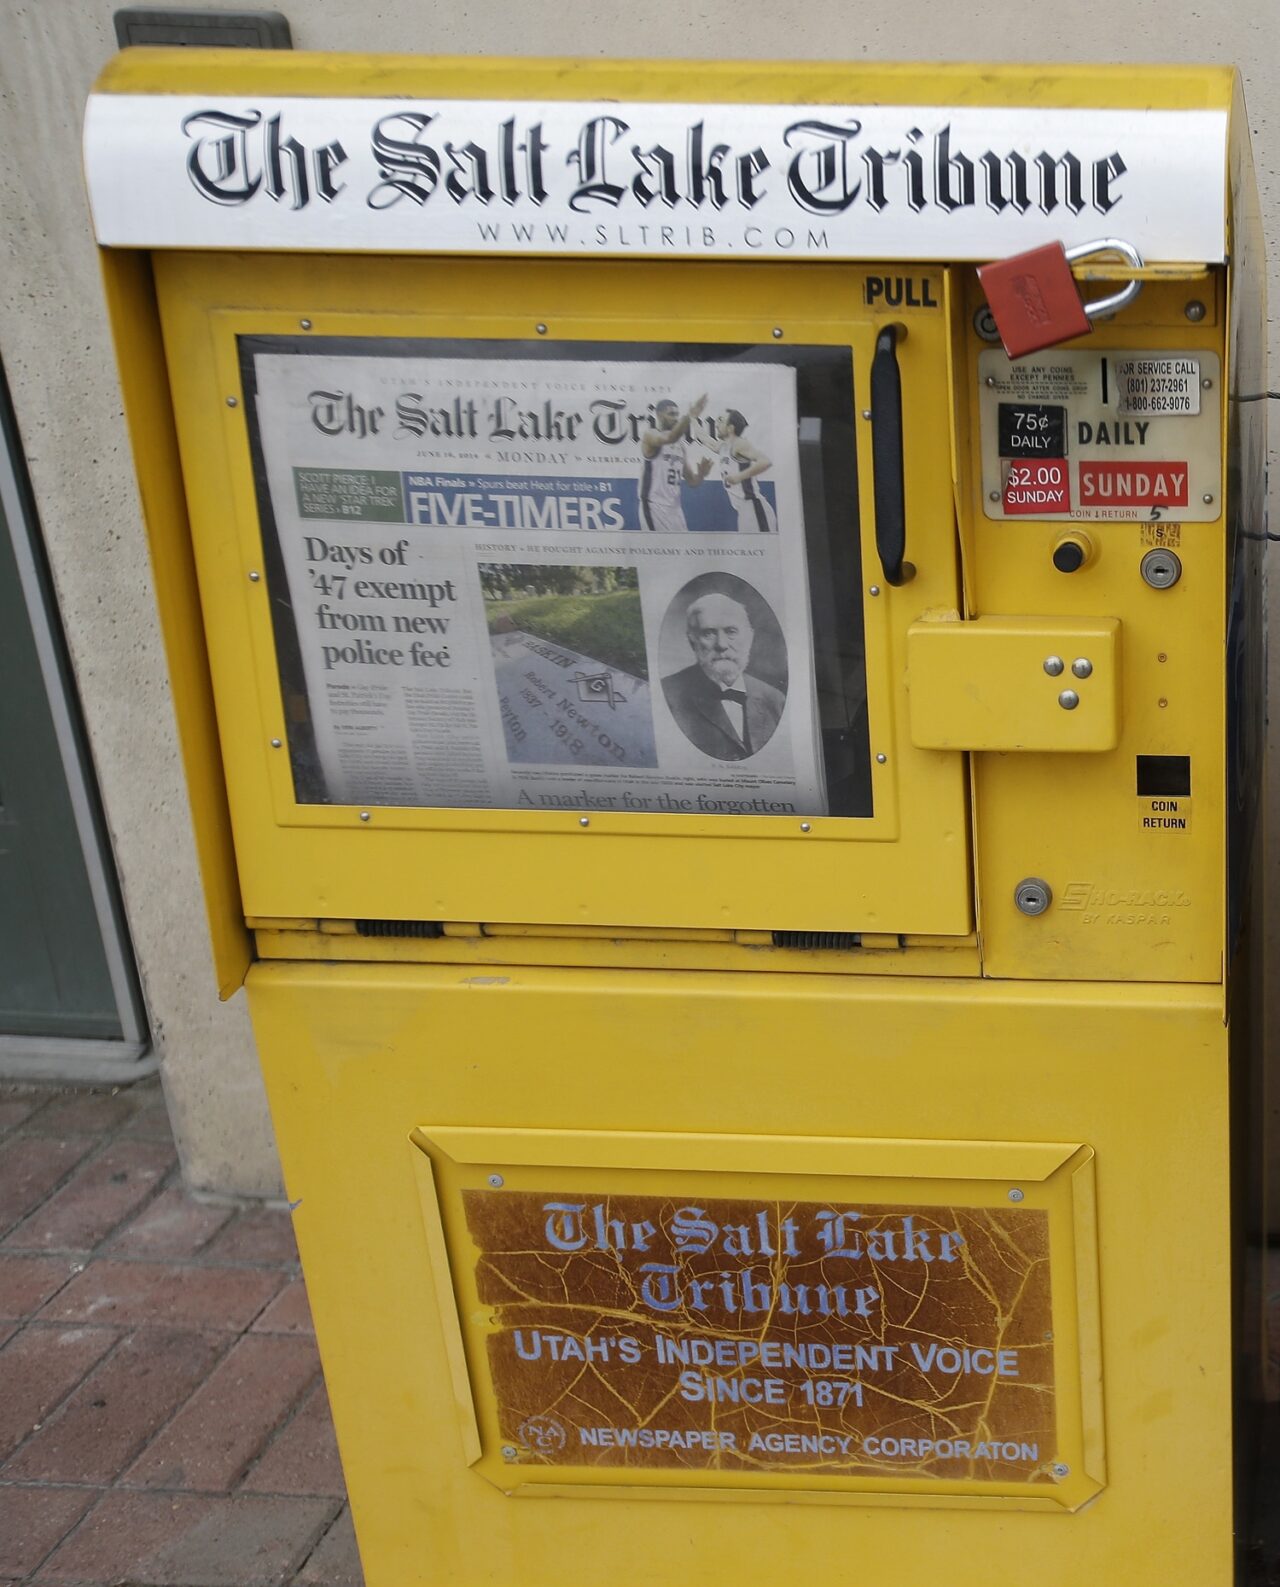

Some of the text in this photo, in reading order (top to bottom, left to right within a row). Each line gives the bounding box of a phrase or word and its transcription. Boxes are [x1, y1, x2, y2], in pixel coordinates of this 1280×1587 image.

[181, 109, 1128, 217] The Salt Lake Tribune
[477, 222, 830, 249] WWW.SLTRIB.COM
[866, 277, 938, 308] PULL
[1137, 362, 1196, 375] SERVICE CALL
[1127, 378, 1189, 394] (801) 237-2961
[1125, 396, 1190, 411] 1-800-662-9076
[307, 389, 584, 443] The Salt Lake
[1013, 412, 1049, 431] 75¢
[1011, 434, 1052, 448] DAILY
[1078, 421, 1149, 446] DAILY
[496, 451, 569, 465] MONDAY
[298, 472, 332, 483] SCOTT
[408, 475, 594, 493] NBA Finals Spurs beat Heat for title
[1008, 466, 1061, 486] $2.00
[1083, 472, 1185, 498] SUNDAY
[300, 484, 398, 497] HAVE IDEA FOR
[1007, 490, 1064, 504] SUNDAY
[343, 505, 363, 516] B12
[409, 491, 625, 531] FIVE-TIMERS
[1069, 510, 1138, 519] COIN RETURN
[1150, 504, 1168, 520] 5
[303, 536, 409, 570] Days of
[308, 568, 457, 609] '47 exempt
[315, 604, 451, 636] from new
[321, 639, 451, 669] police fee
[517, 789, 796, 816] A marker for the forgotten
[1152, 801, 1178, 812] COIN
[1143, 818, 1186, 829] RETURN
[1107, 914, 1171, 925] KASPAR
[542, 1202, 966, 1265] The Salt Lake
[638, 1260, 881, 1319] Tribune
[514, 1330, 1020, 1377] UTAH'S INDEPENDENT VOICE
[679, 1371, 865, 1408] SINCE 1871
[579, 1427, 736, 1450] NEWSPAPER
[748, 1432, 854, 1455] AGENCY
[863, 1437, 1038, 1462] CORPORATON
